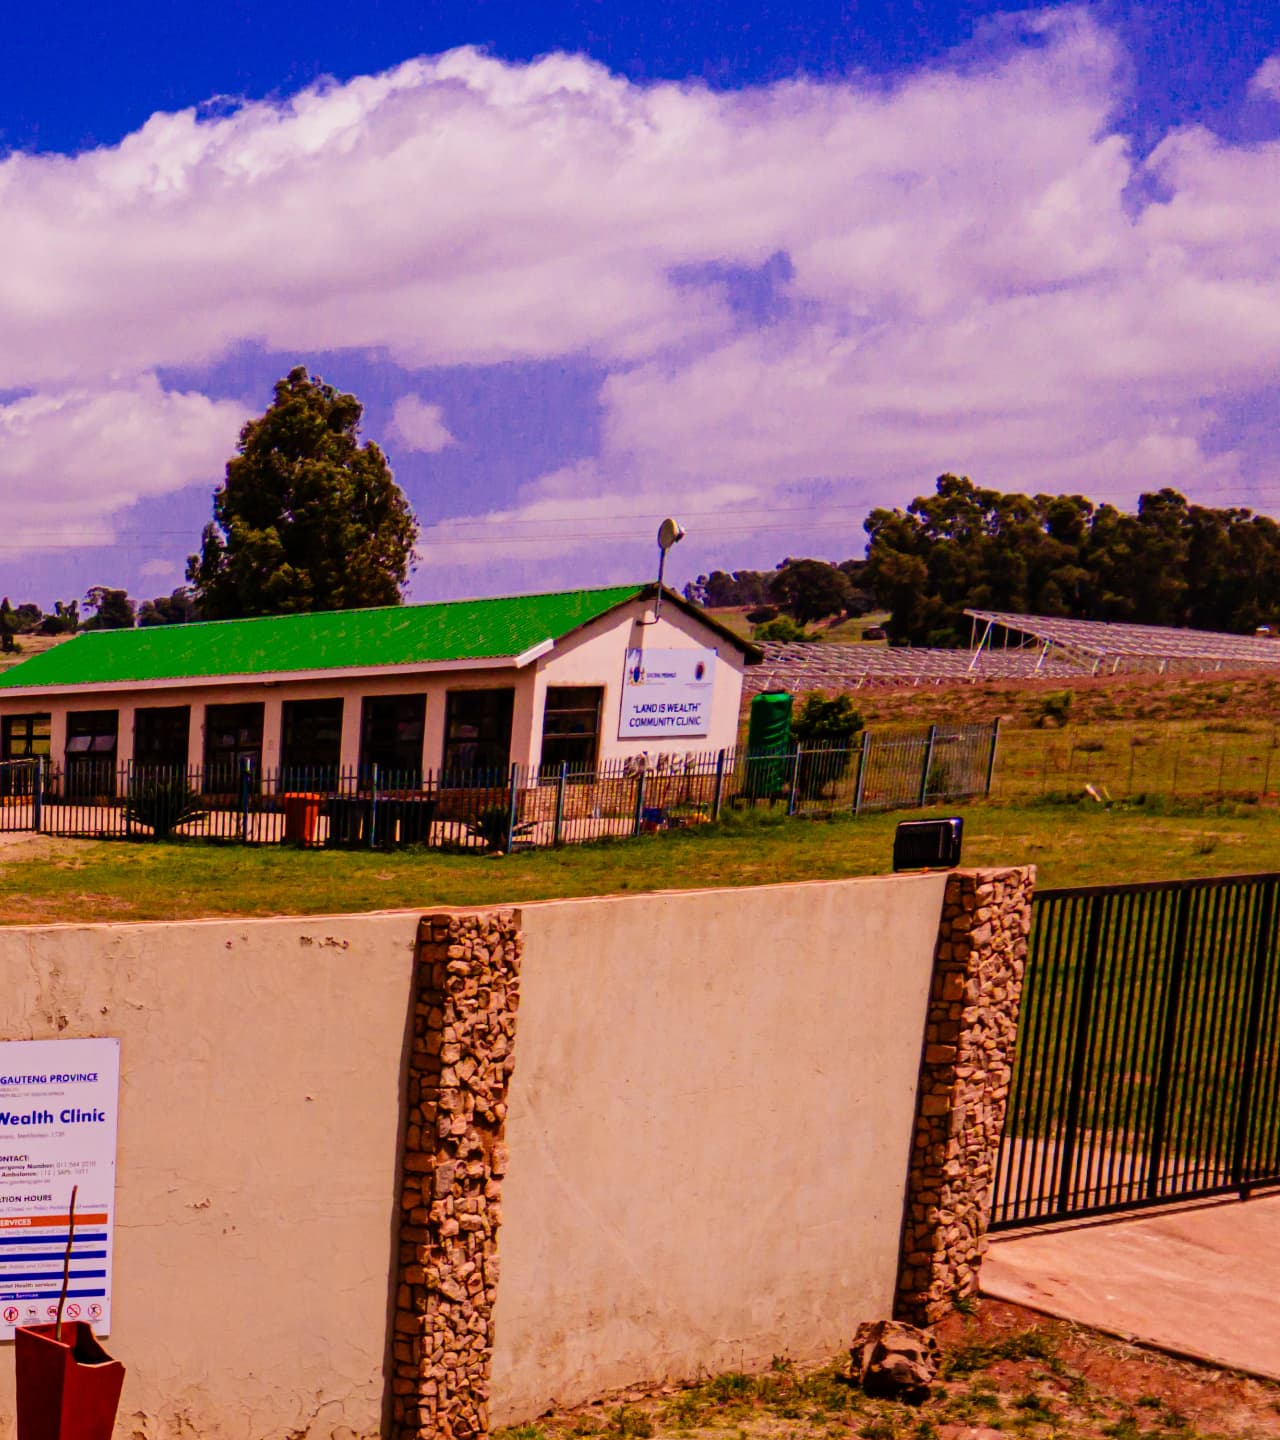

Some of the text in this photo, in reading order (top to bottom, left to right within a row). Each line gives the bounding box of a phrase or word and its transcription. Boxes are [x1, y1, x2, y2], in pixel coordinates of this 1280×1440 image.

[658, 703, 666, 713] IS
[629, 716, 702, 727] COMMUNITY CLINIC
[0, 1073, 98, 1085] GAUTENG PROVINCE
[60, 1108, 105, 1123] Clinic
[24, 1194, 52, 1202] HOURS
